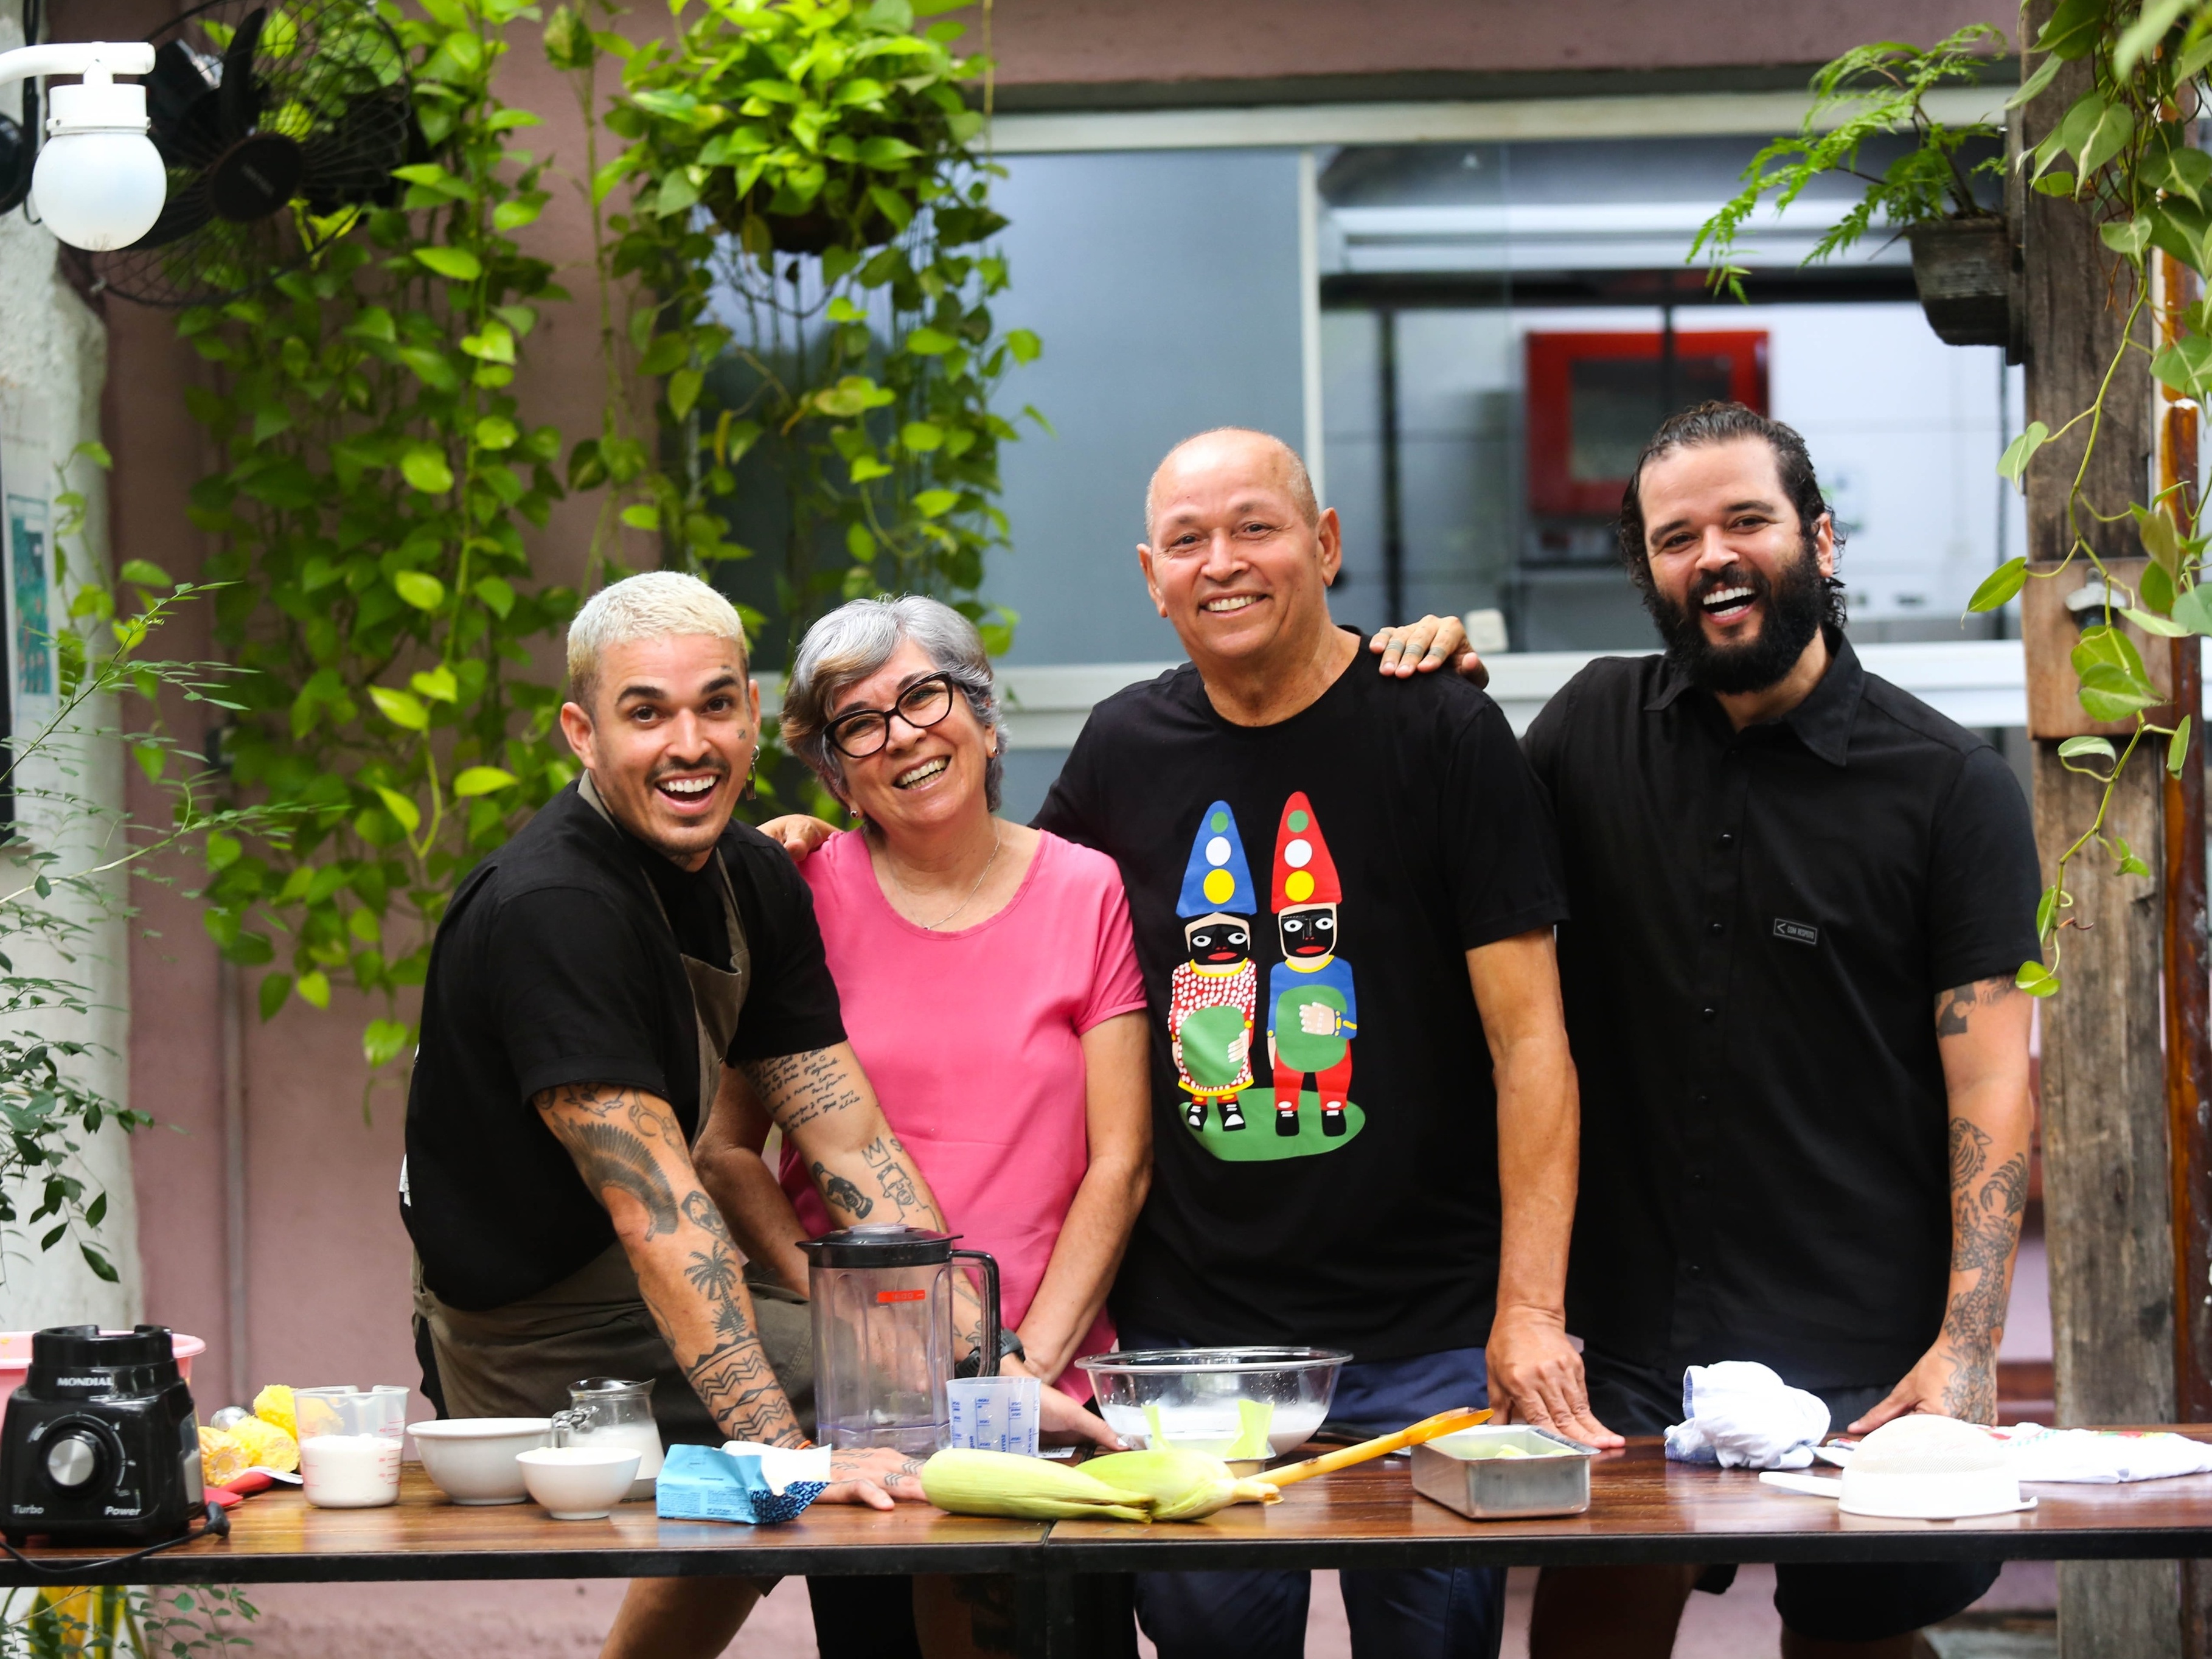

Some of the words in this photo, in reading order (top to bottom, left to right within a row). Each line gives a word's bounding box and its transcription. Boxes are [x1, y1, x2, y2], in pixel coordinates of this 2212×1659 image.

[57, 1377, 114, 1387] MONDIAL
[12, 1504, 44, 1515] Turbo
[105, 1505, 142, 1516] Power
